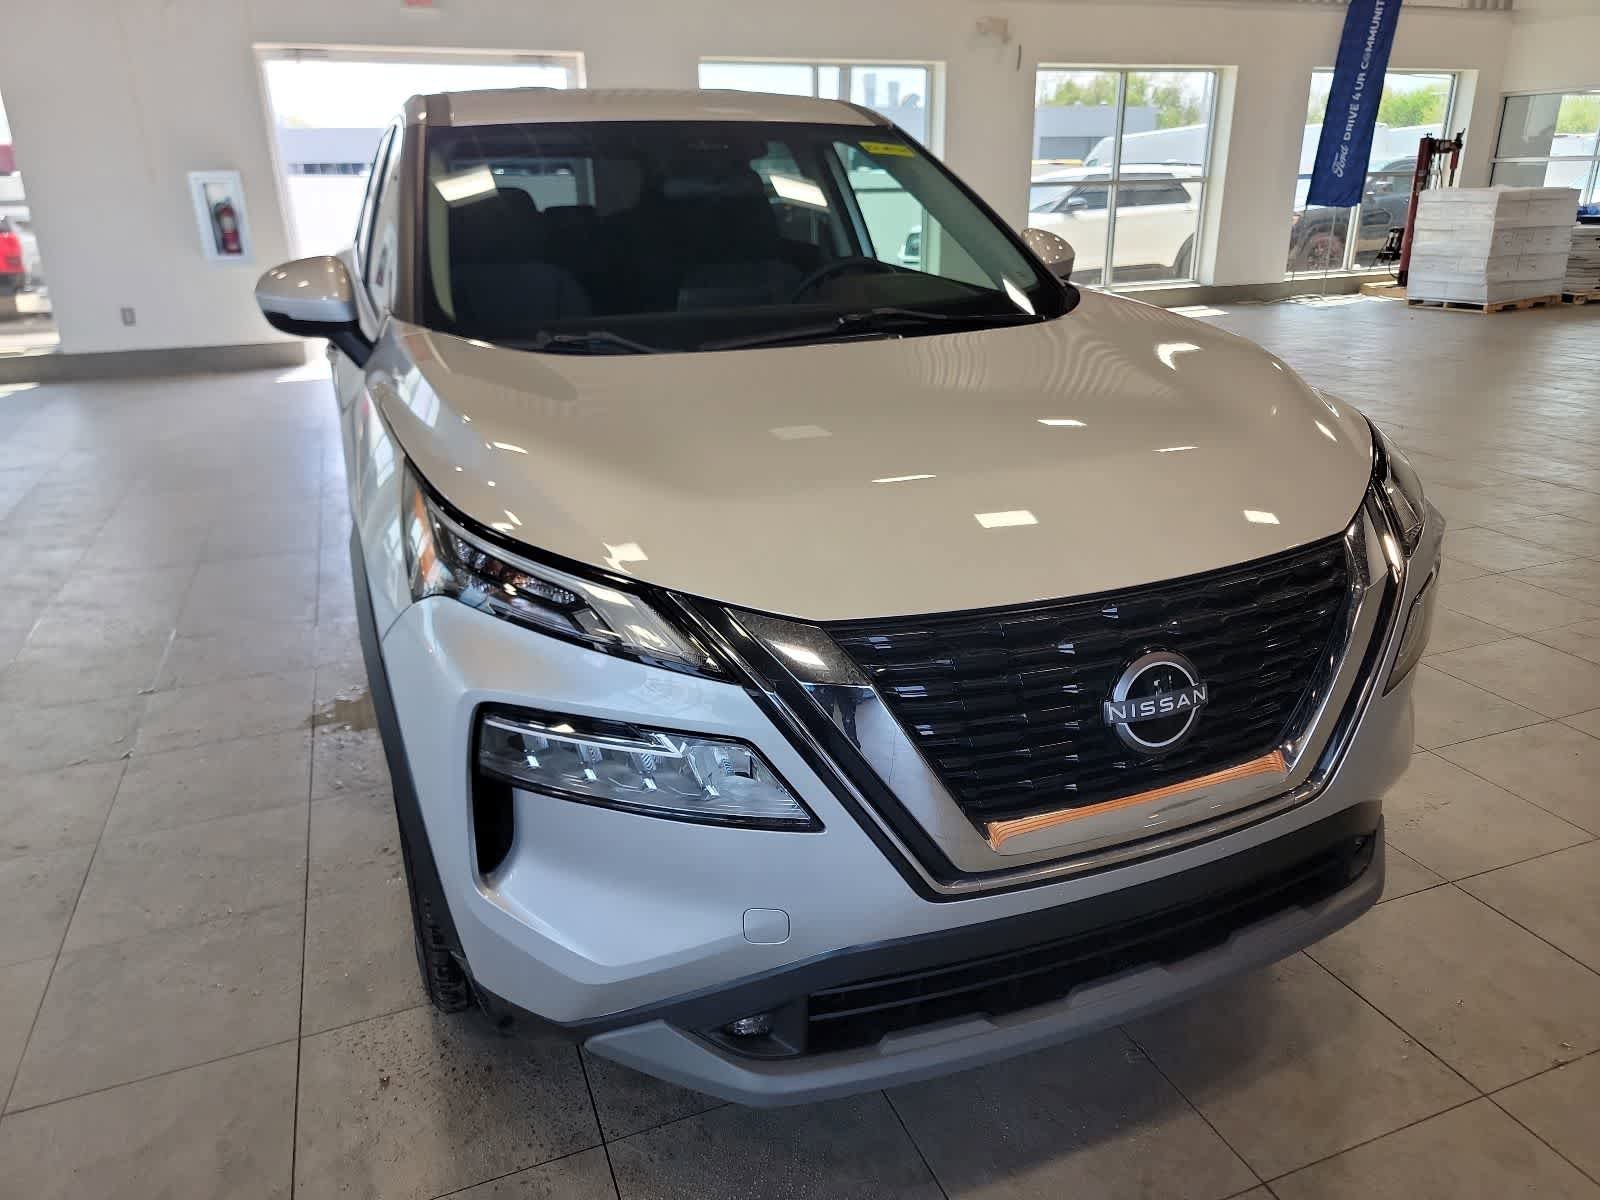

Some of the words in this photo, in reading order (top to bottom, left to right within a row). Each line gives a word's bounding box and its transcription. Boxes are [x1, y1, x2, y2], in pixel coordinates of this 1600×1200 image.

[1331, 146, 1350, 178] Ford
[1343, 103, 1360, 141] DRIVE
[1354, 73, 1367, 91] UR
[1109, 686, 1206, 721] NISSAN
